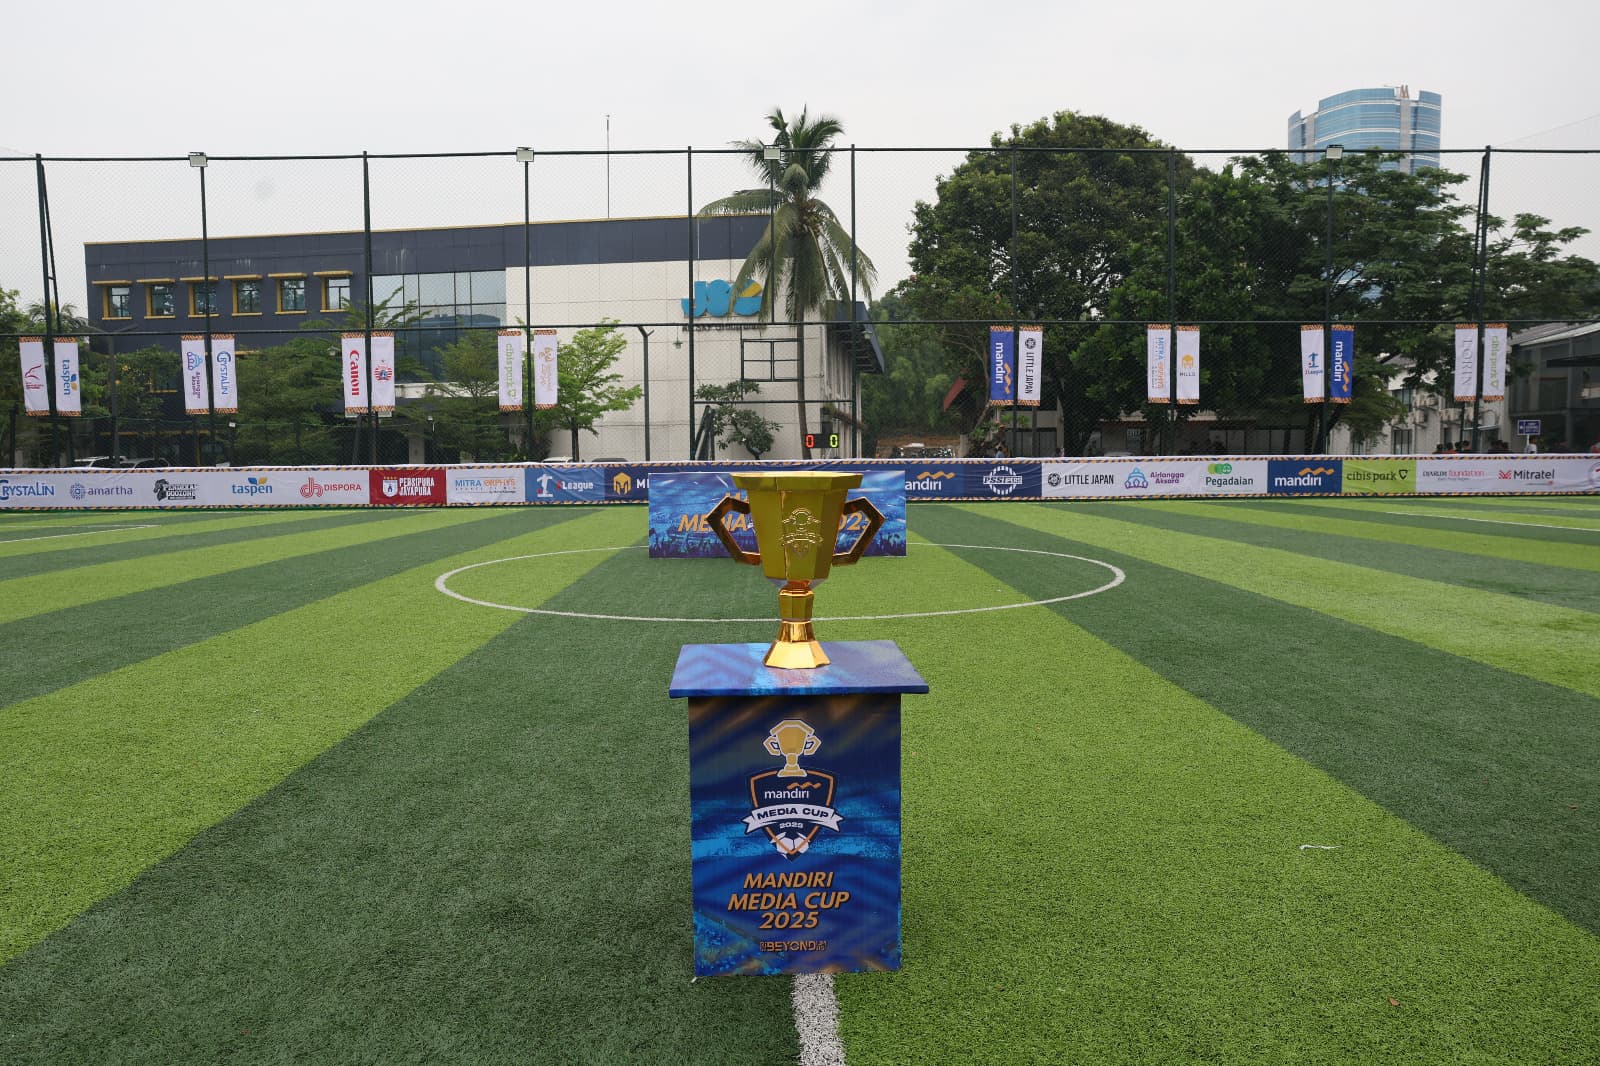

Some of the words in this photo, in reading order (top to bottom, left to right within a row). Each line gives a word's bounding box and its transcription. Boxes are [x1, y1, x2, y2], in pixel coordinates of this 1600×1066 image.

[995, 342, 1006, 384] mandiri
[1025, 352, 1035, 373] LITTLE
[1334, 341, 1344, 382] mandiri
[61, 360, 71, 395] taspen
[217, 351, 231, 395] CRYSTALIN
[350, 350, 360, 396] Canon
[1025, 373, 1034, 394] JAPAN
[805, 434, 815, 448] 0
[829, 434, 839, 448] 0
[1064, 475, 1089, 485] LITTLE
[1091, 474, 1114, 485] JAPAN
[1150, 471, 1184, 479] Airlangga
[1274, 474, 1321, 486] mandiri
[1373, 471, 1397, 483] park
[1514, 469, 1555, 480] Mitratel
[324, 484, 362, 492] DISPORA
[399, 478, 435, 487] PERSIPURA
[905, 478, 942, 490] andiri
[1206, 475, 1254, 488] Pegadaian
[88, 486, 133, 496] amartha
[232, 483, 273, 496] taspen
[399, 487, 432, 496] JAYAPURA
[678, 514, 747, 532] MEIA
[764, 788, 810, 799] mandiri
[757, 808, 798, 820] MEDIA
[802, 808, 829, 818] CUP
[743, 871, 834, 889] MANDIRI
[727, 892, 797, 911] MEDIA
[804, 891, 850, 910] CUP
[759, 911, 819, 929] 2025
[767, 941, 816, 952] BEYOND
